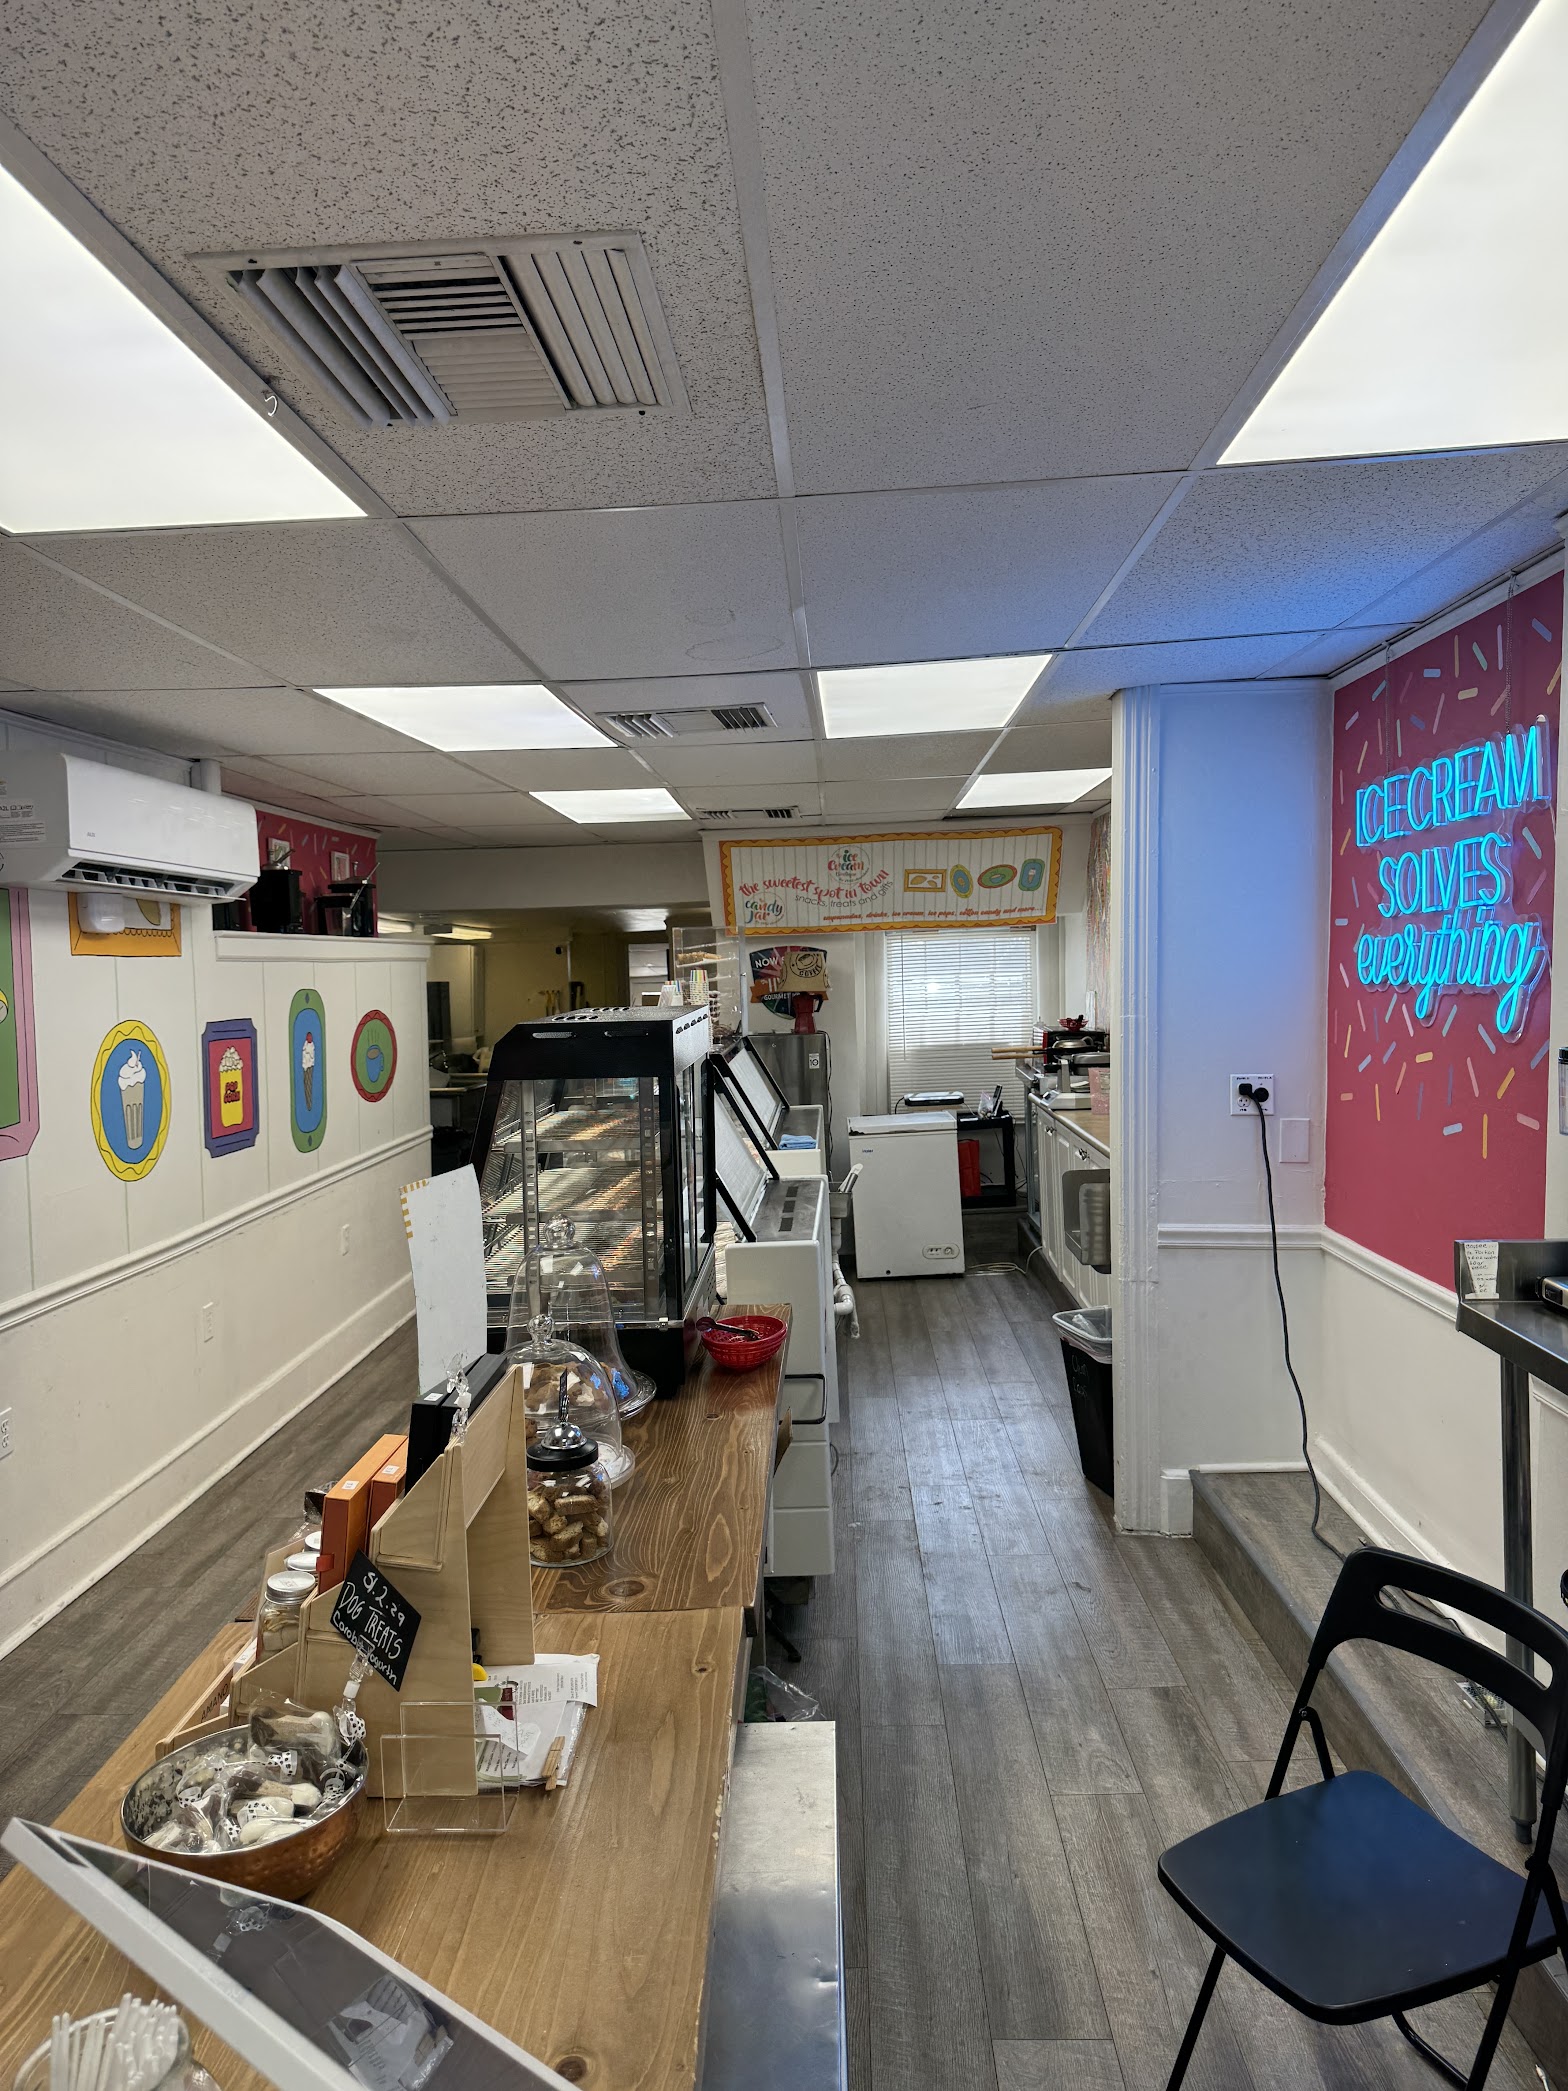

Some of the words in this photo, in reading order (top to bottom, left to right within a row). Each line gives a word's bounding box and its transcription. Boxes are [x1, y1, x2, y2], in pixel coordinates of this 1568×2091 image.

[843, 849, 858, 862] ice
[739, 882, 760, 897] the
[763, 876, 815, 893] sweetest
[813, 886, 845, 901] spot
[844, 889, 857, 899] in
[858, 869, 890, 894] town
[1378, 833, 1511, 917] SOLVES
[830, 899, 857, 908] treats
[858, 893, 878, 905] and
[878, 880, 894, 897] gifts
[745, 899, 783, 916] candy
[1003, 906, 1018, 914] and
[755, 956, 779, 969] NOW
[1357, 906, 1546, 1034] everything
[763, 992, 791, 1001] GOURMET
[338, 1582, 366, 1620] DOG
[364, 1605, 403, 1660] TREATS
